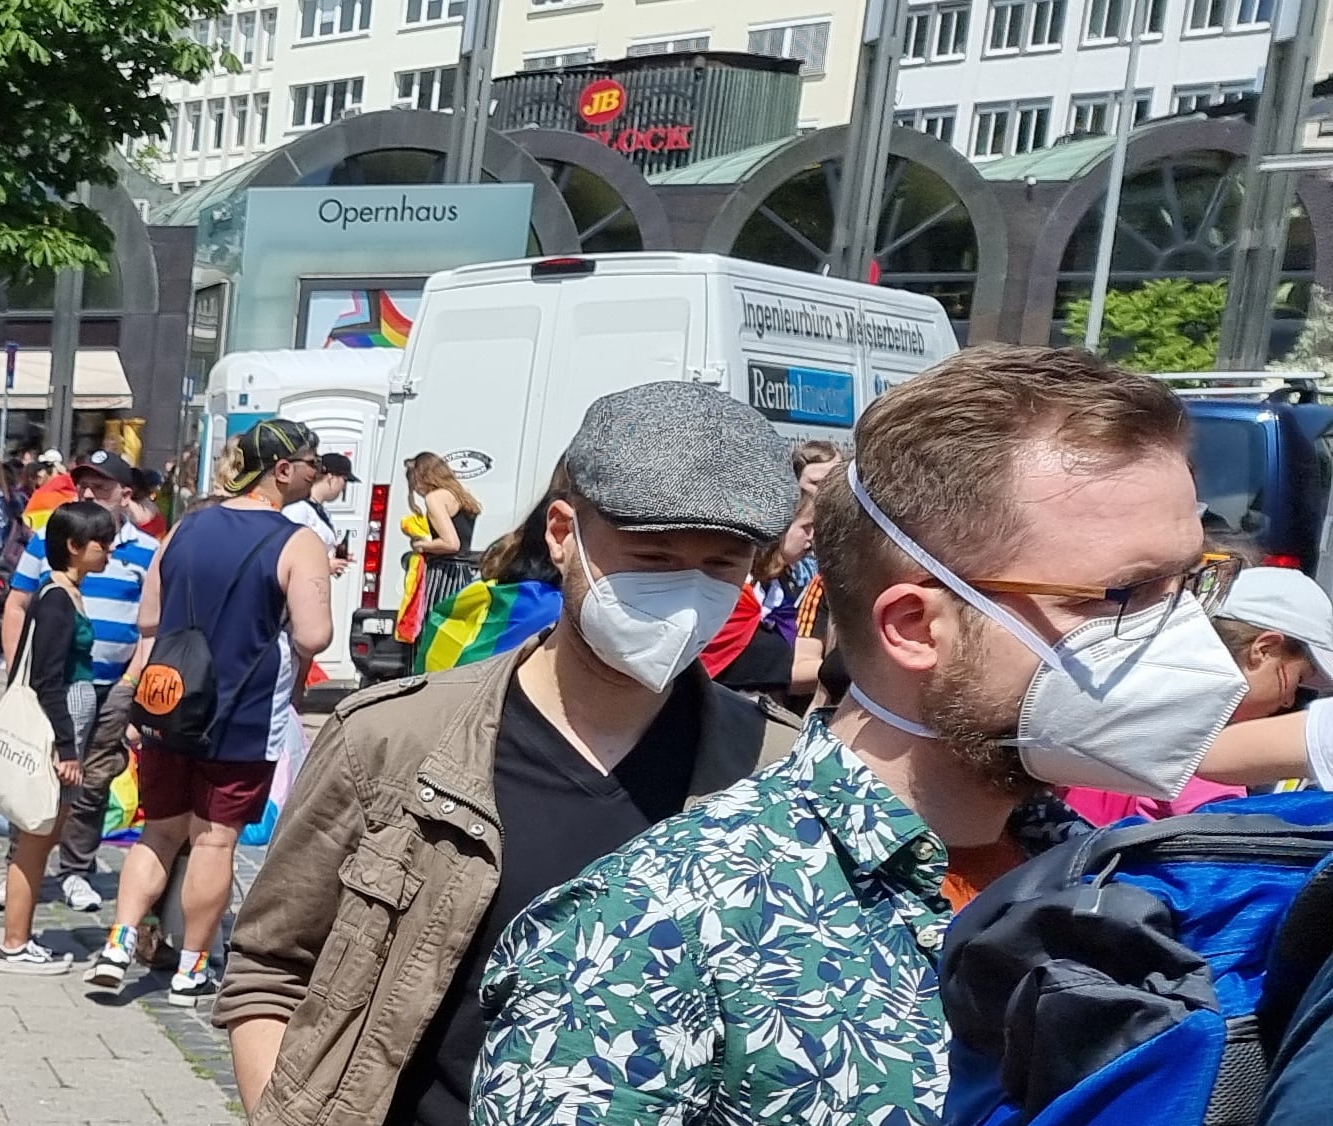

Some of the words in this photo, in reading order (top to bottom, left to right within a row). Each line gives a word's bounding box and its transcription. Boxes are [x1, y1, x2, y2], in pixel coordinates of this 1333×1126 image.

[583, 88, 621, 116] JB
[318, 194, 459, 231] Opernhaus
[740, 292, 834, 341] Ingenieurbüro
[844, 309, 926, 356] Meisterbetrieb
[142, 672, 179, 707] YEAH
